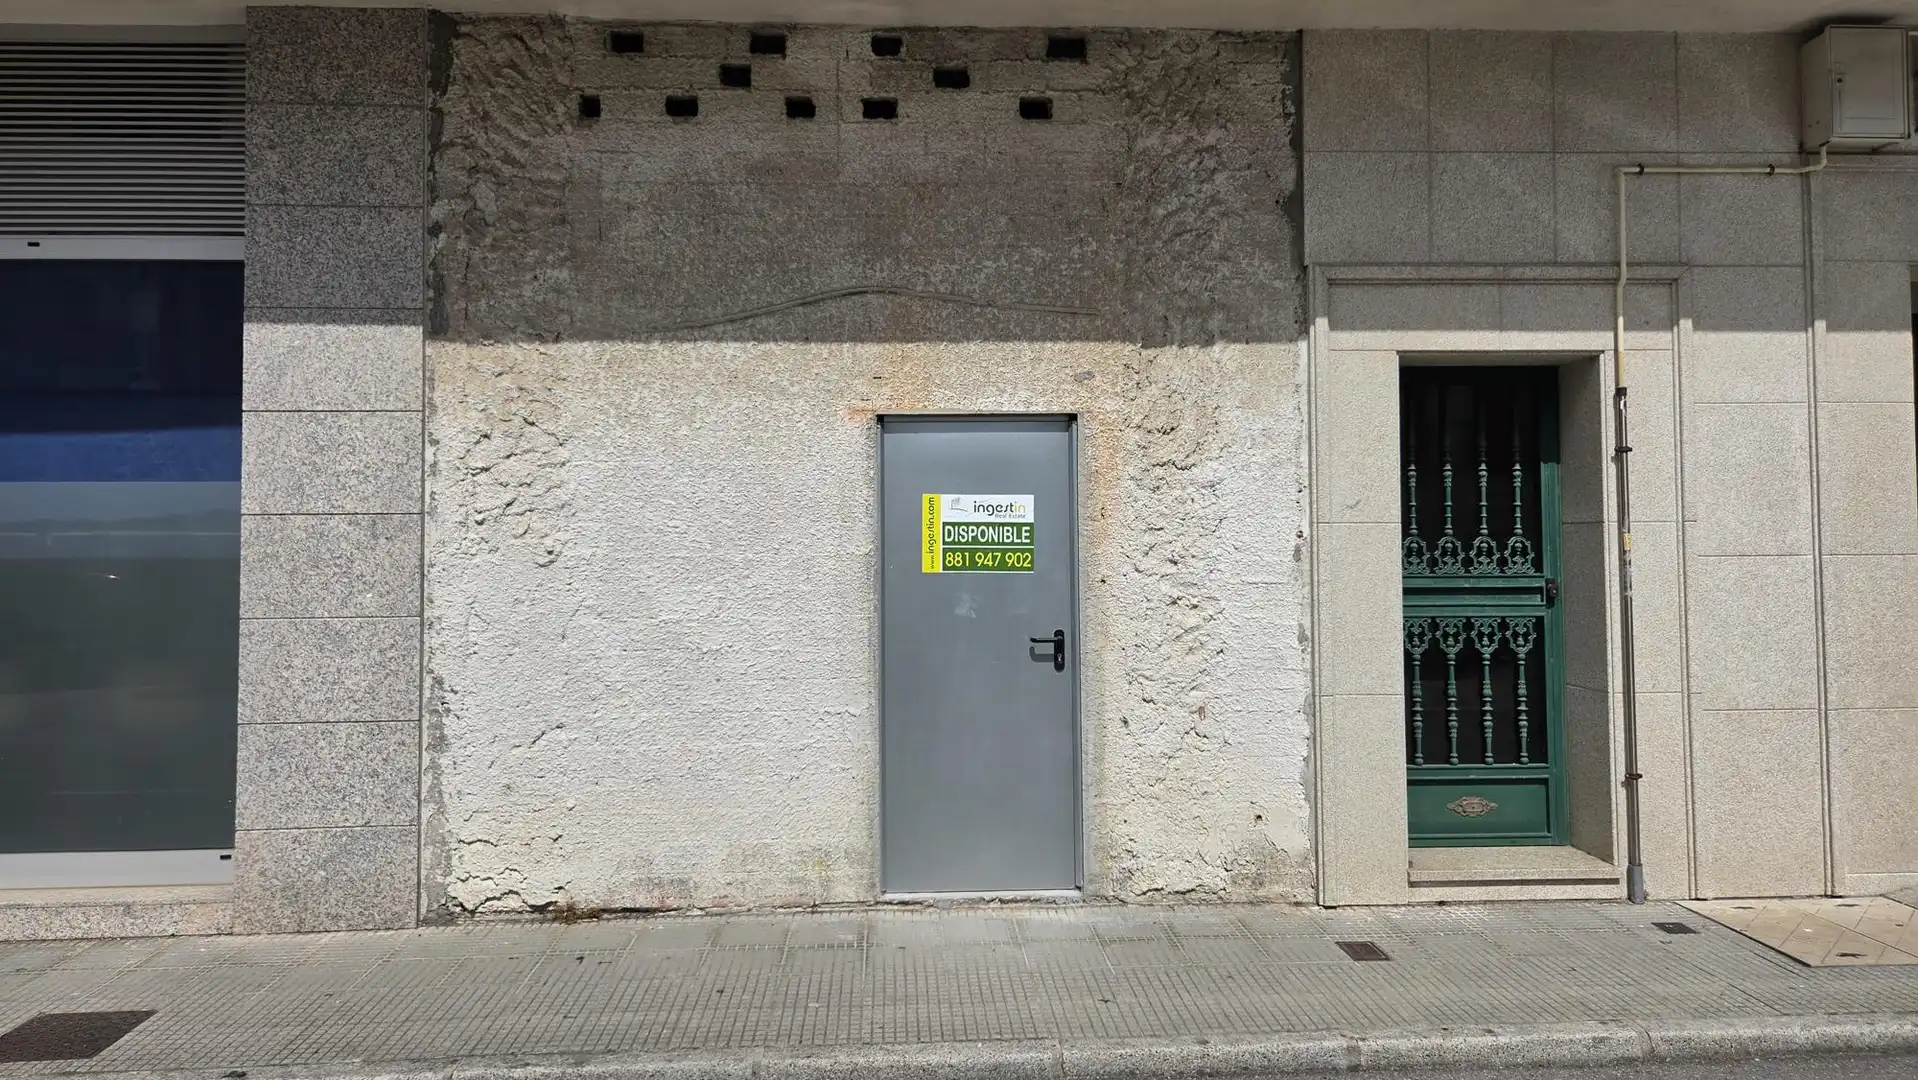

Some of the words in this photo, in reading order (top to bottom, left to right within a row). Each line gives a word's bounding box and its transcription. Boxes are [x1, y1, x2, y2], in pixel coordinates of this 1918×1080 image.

[973, 500, 1026, 517] ingestin
[926, 496, 937, 570] www.ingestin.com
[944, 525, 1031, 543] DISPONIBLE
[945, 552, 970, 567] 881
[975, 552, 1001, 567] 947
[1005, 552, 1032, 568] 902
